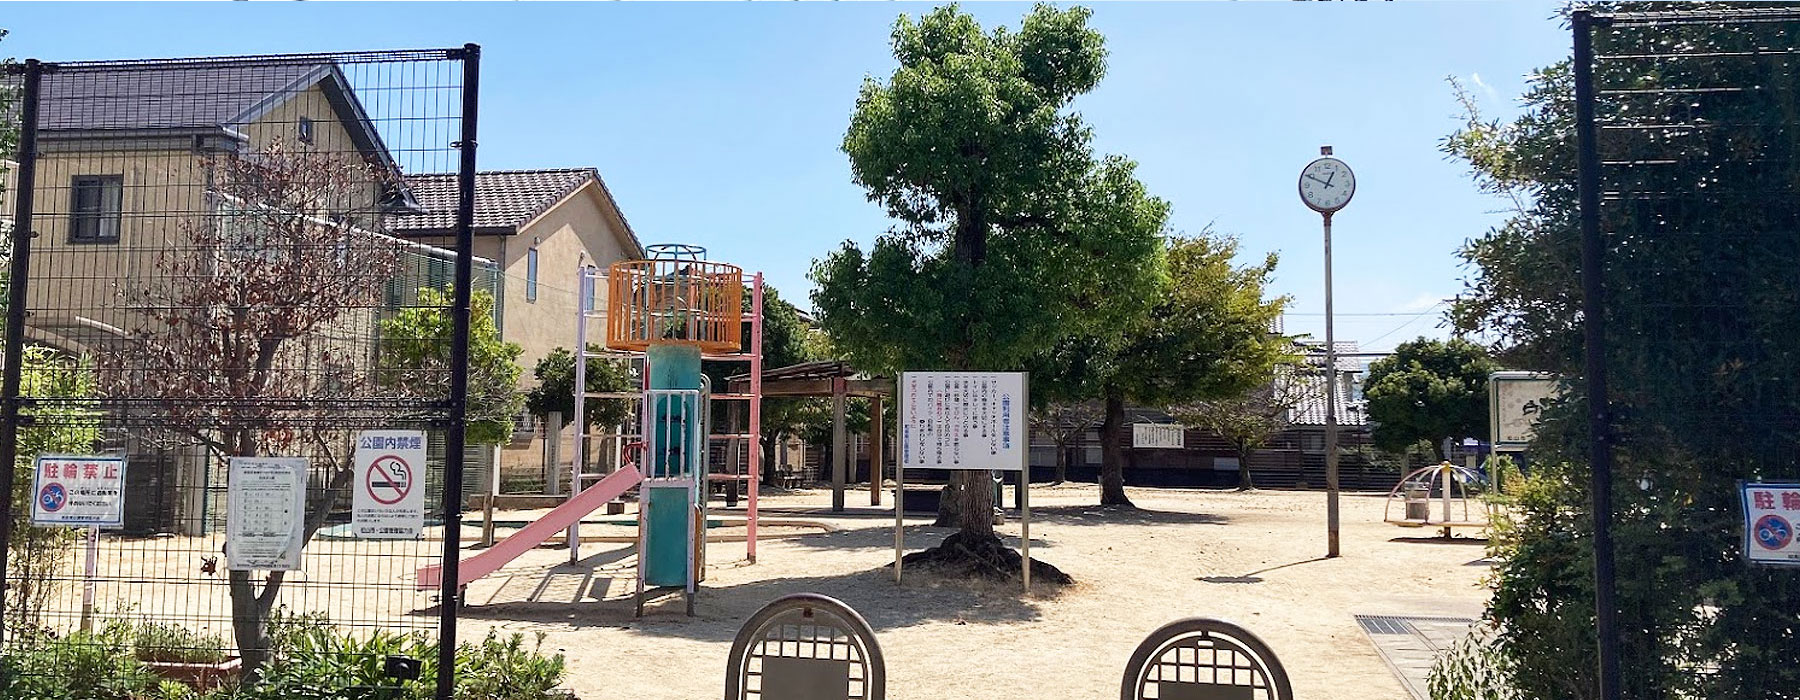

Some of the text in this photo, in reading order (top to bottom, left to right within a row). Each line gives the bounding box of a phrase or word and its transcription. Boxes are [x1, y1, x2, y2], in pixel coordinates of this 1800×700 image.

[360, 436, 421, 450] 公園内禁煙
[44, 463, 118, 479] 駐輪禁止
